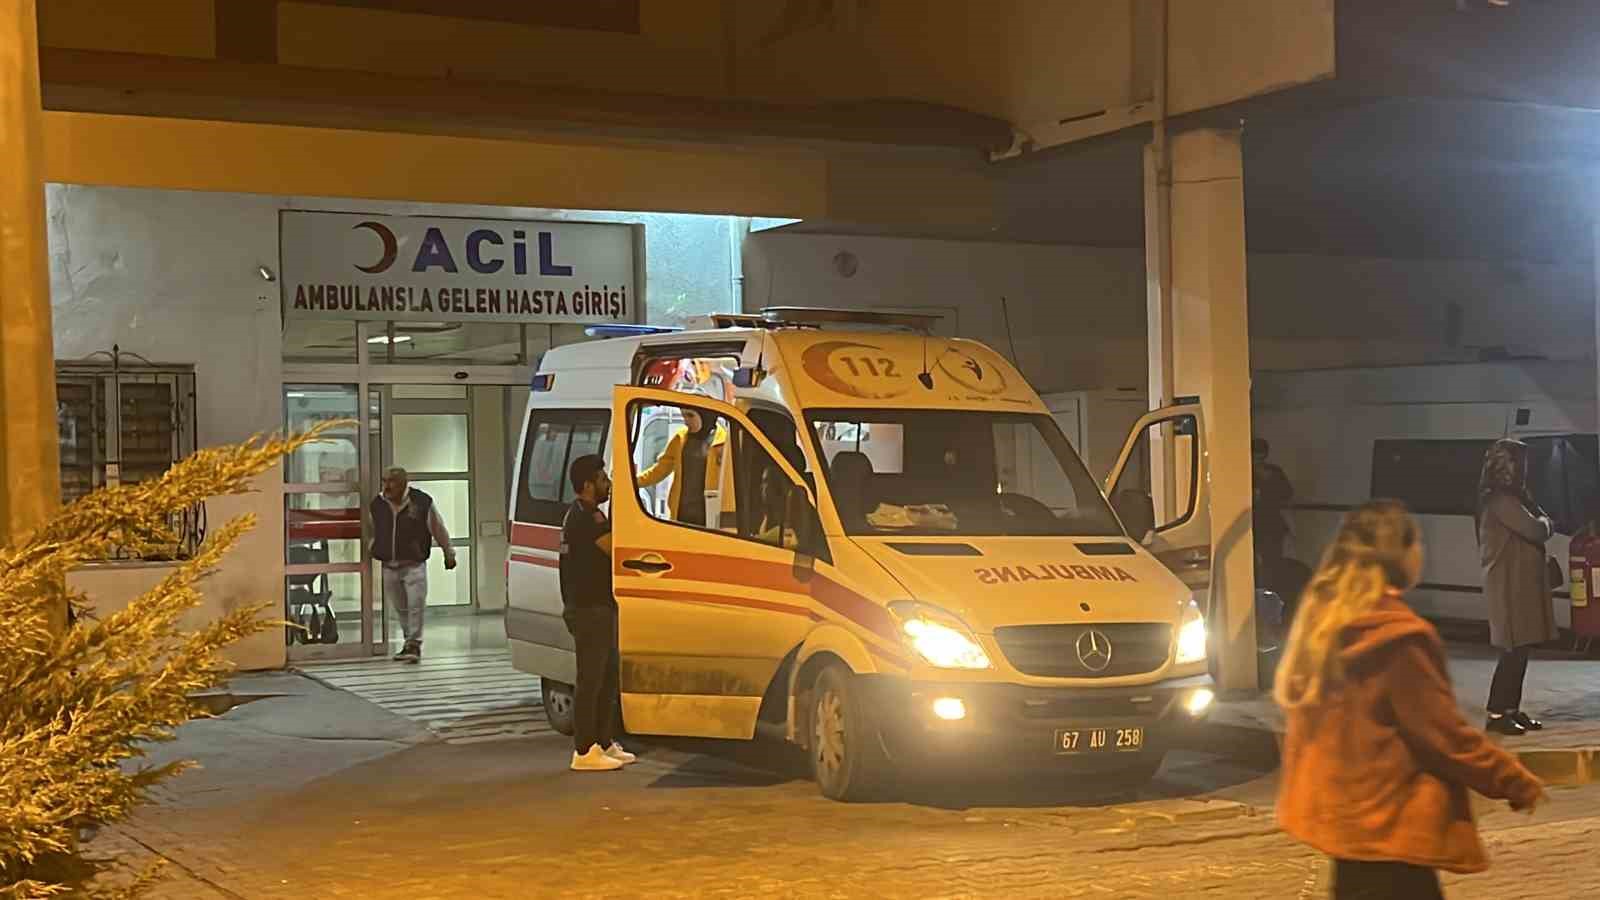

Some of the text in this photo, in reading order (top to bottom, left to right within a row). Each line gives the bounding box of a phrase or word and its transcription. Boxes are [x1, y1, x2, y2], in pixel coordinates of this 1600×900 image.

[294, 284, 626, 319] AMBULANSLA GELEN HASTA GİRİŞİ
[839, 356, 903, 378] 112
[1062, 729, 1140, 749] 67 AU 258
